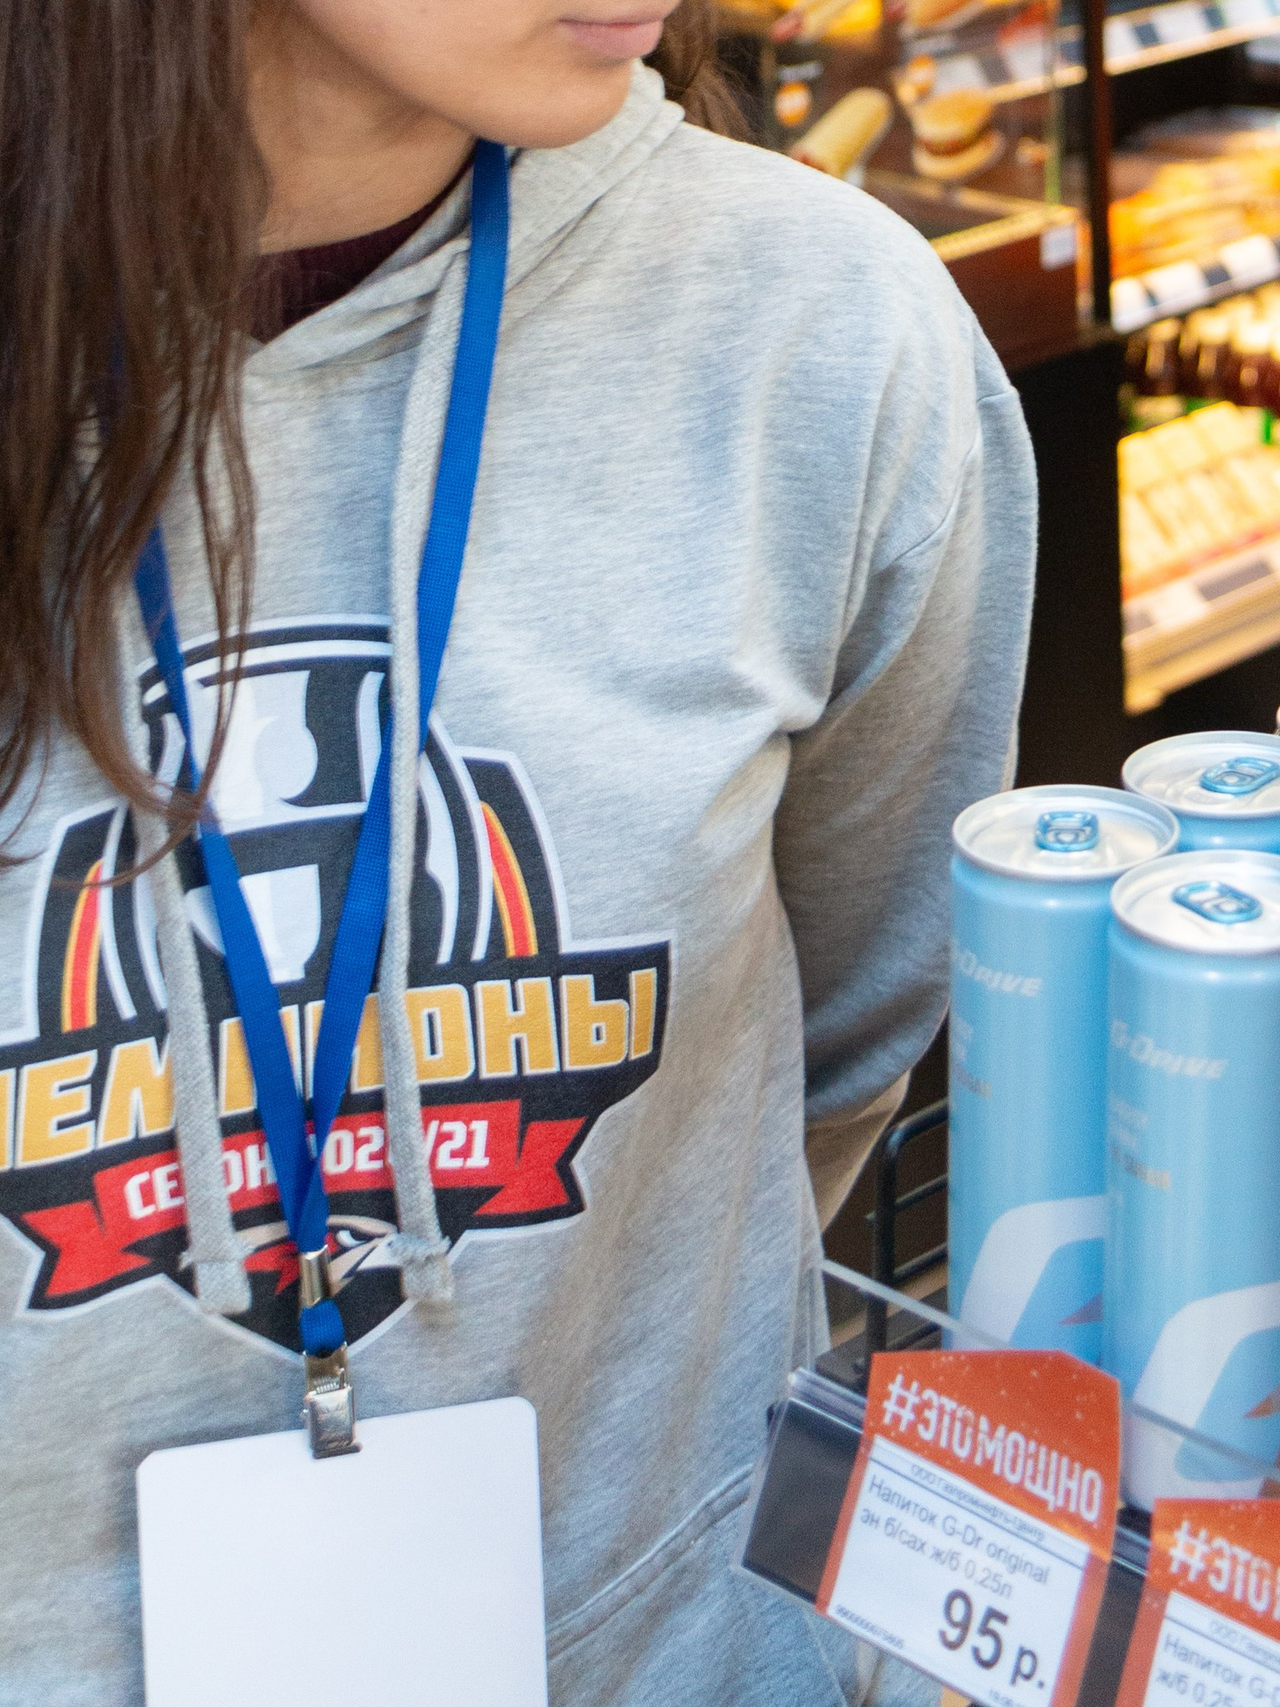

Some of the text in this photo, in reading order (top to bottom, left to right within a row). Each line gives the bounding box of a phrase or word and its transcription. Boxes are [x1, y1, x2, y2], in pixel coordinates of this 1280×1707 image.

[124, 1119, 490, 1220] СЕОН 02/21
[860, 1507, 881, 1530] эн
[884, 1516, 926, 1556] б/сах
[929, 1546, 961, 1572] ж/б
[868, 1474, 1051, 1586] Напиток G-Dr original
[938, 1588, 1009, 1670] 95
[1010, 1645, 1046, 1690] р.
[1164, 1632, 1243, 1686] Напиток
